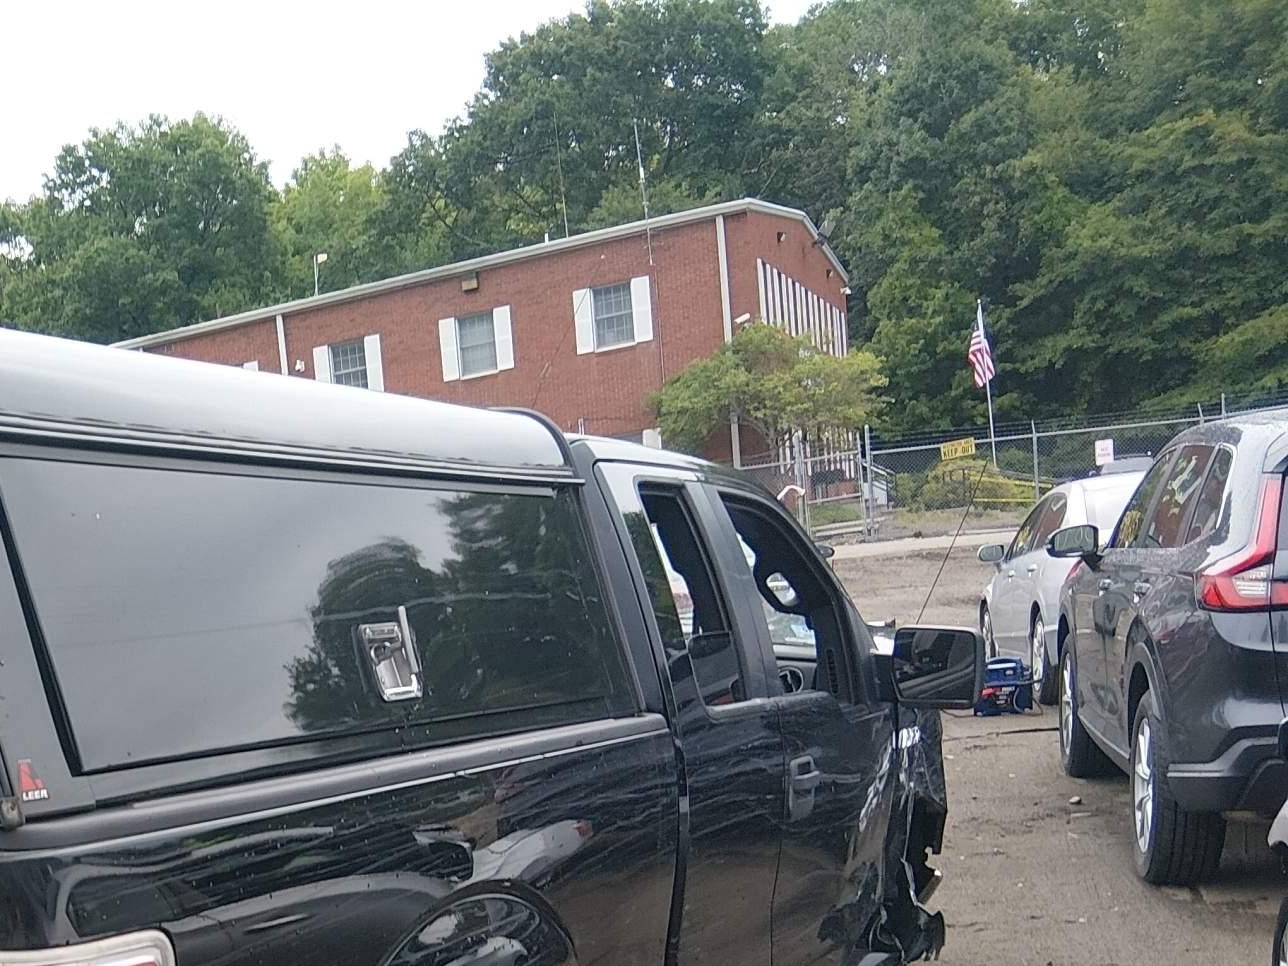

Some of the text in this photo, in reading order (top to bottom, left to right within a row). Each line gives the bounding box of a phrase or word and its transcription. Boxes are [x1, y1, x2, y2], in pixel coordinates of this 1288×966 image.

[943, 447, 958, 458] KEEP
[961, 444, 973, 454] OUT
[22, 789, 49, 801] LEER
